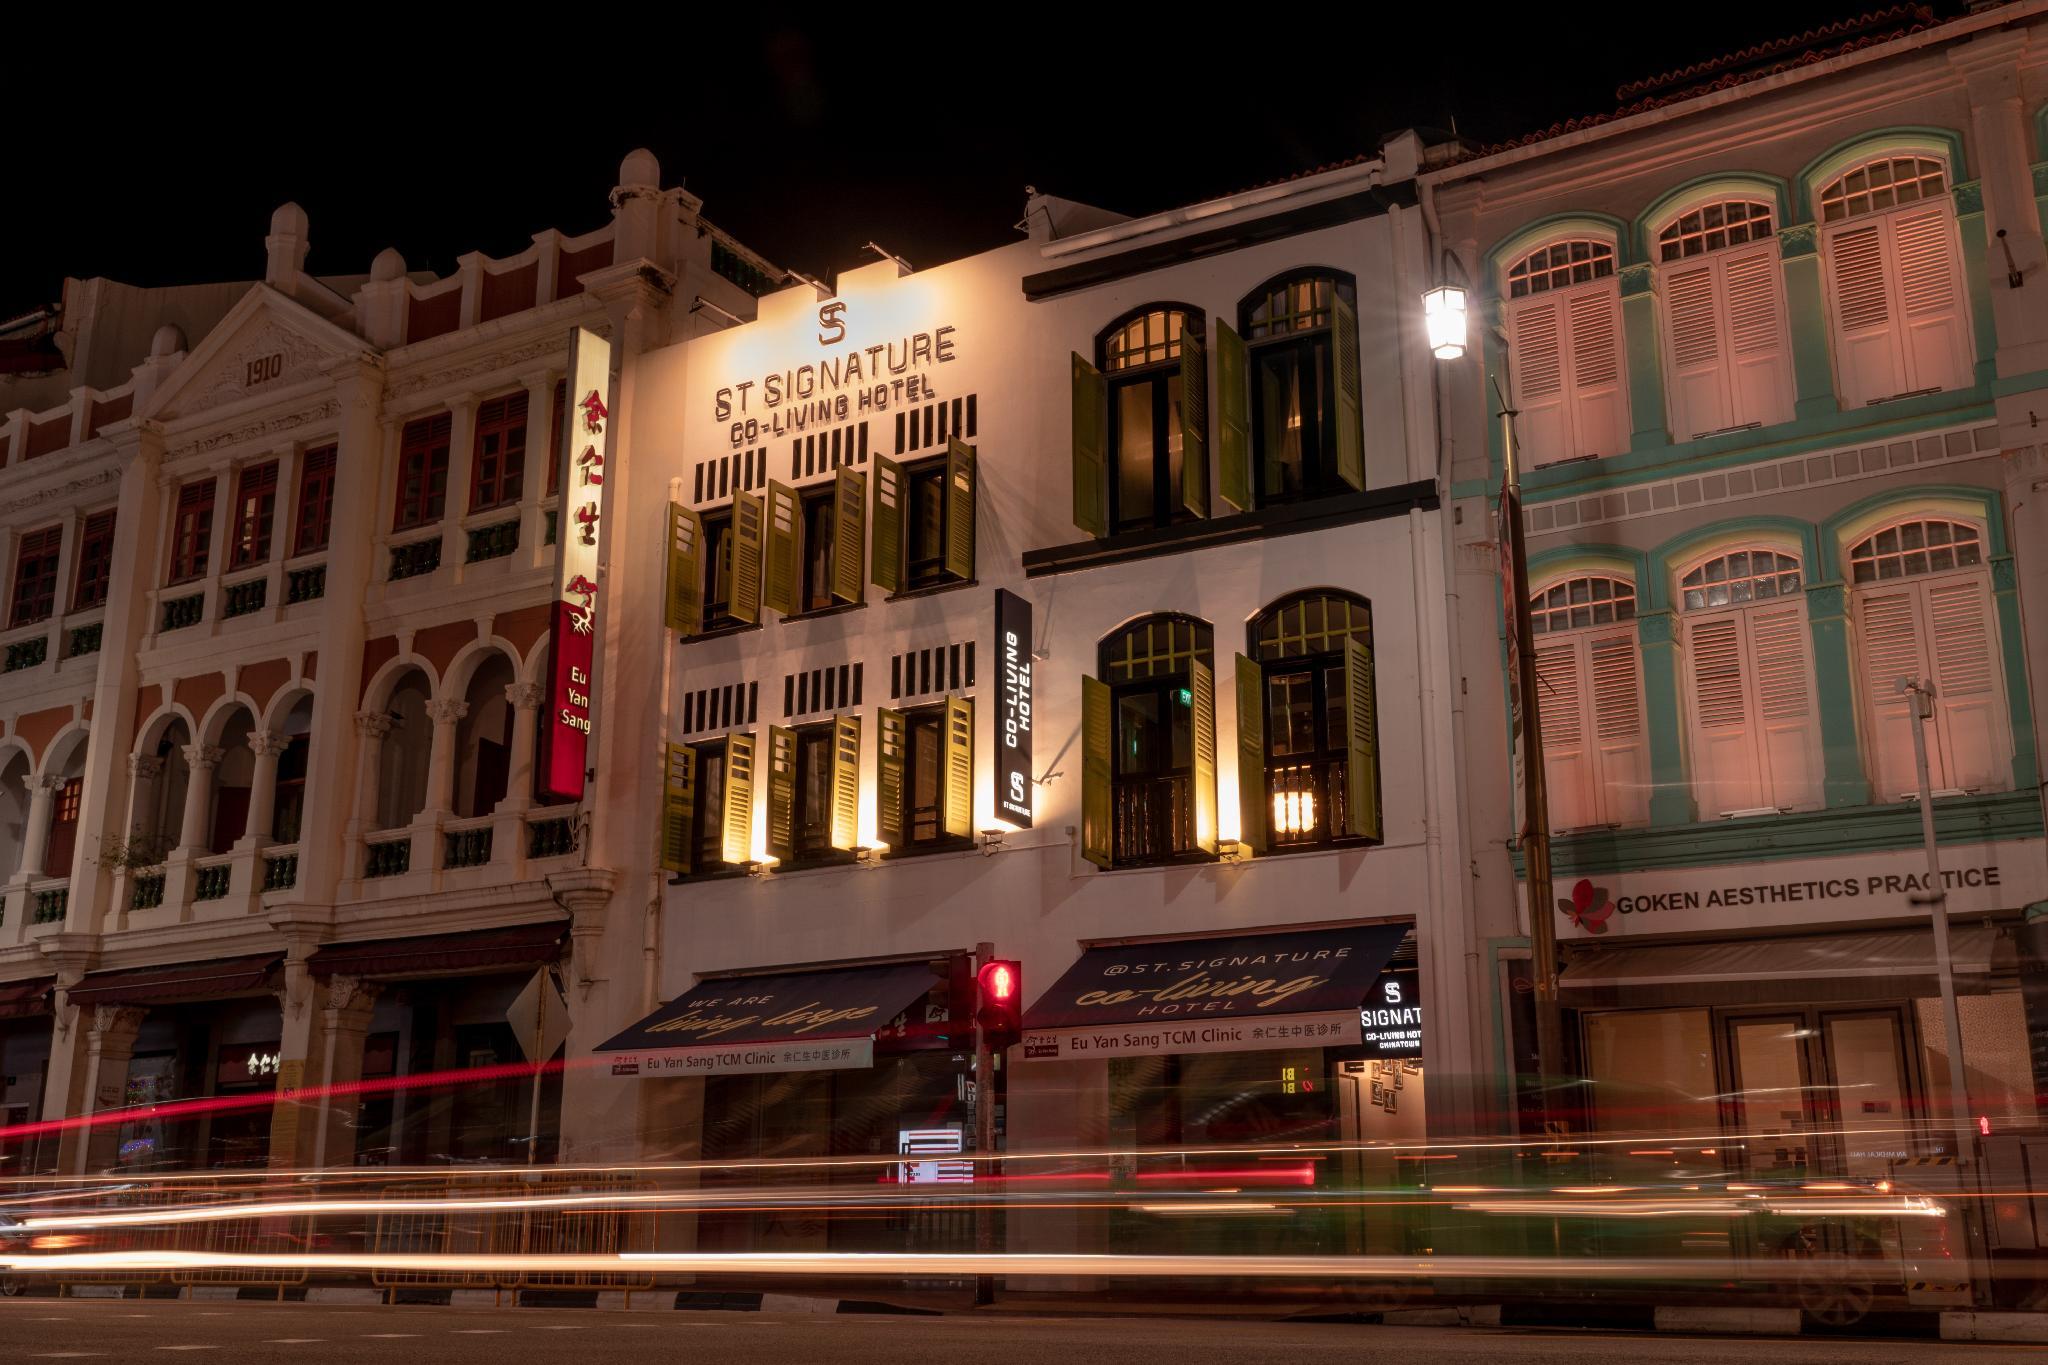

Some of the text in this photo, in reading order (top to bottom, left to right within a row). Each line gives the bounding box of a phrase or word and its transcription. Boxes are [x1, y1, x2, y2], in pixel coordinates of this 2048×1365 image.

[246, 353, 282, 387] 1910
[715, 325, 956, 423] ST SIGNATURE
[730, 373, 935, 446] CO-LIVING HOTEL
[571, 665, 587, 685] Eu
[1006, 631, 1018, 748] CO-LIVING
[567, 687, 588, 709] Yan
[1019, 662, 1031, 732] HOTEL
[561, 708, 591, 735] Sang
[1616, 890, 1700, 916] GOKEN
[1706, 878, 1860, 908] AESTHETICS
[1102, 947, 1353, 977] @ST.SIGNATURE
[688, 994, 774, 1009] WE ARE
[1076, 971, 1332, 1008] co-living
[645, 1001, 880, 1040] living large
[1137, 1001, 1236, 1016] HOTEL
[1071, 1037, 1090, 1051] Eu
[1093, 1035, 1119, 1050] Yan
[1122, 1033, 1160, 1051] Sang
[1162, 1030, 1196, 1045] TCM
[1201, 1028, 1242, 1044] Clinic
[1252, 1023, 1342, 1040] 余仁生中医诊所
[647, 1052, 776, 1070] Eu Yan Sang TCM Clinic
